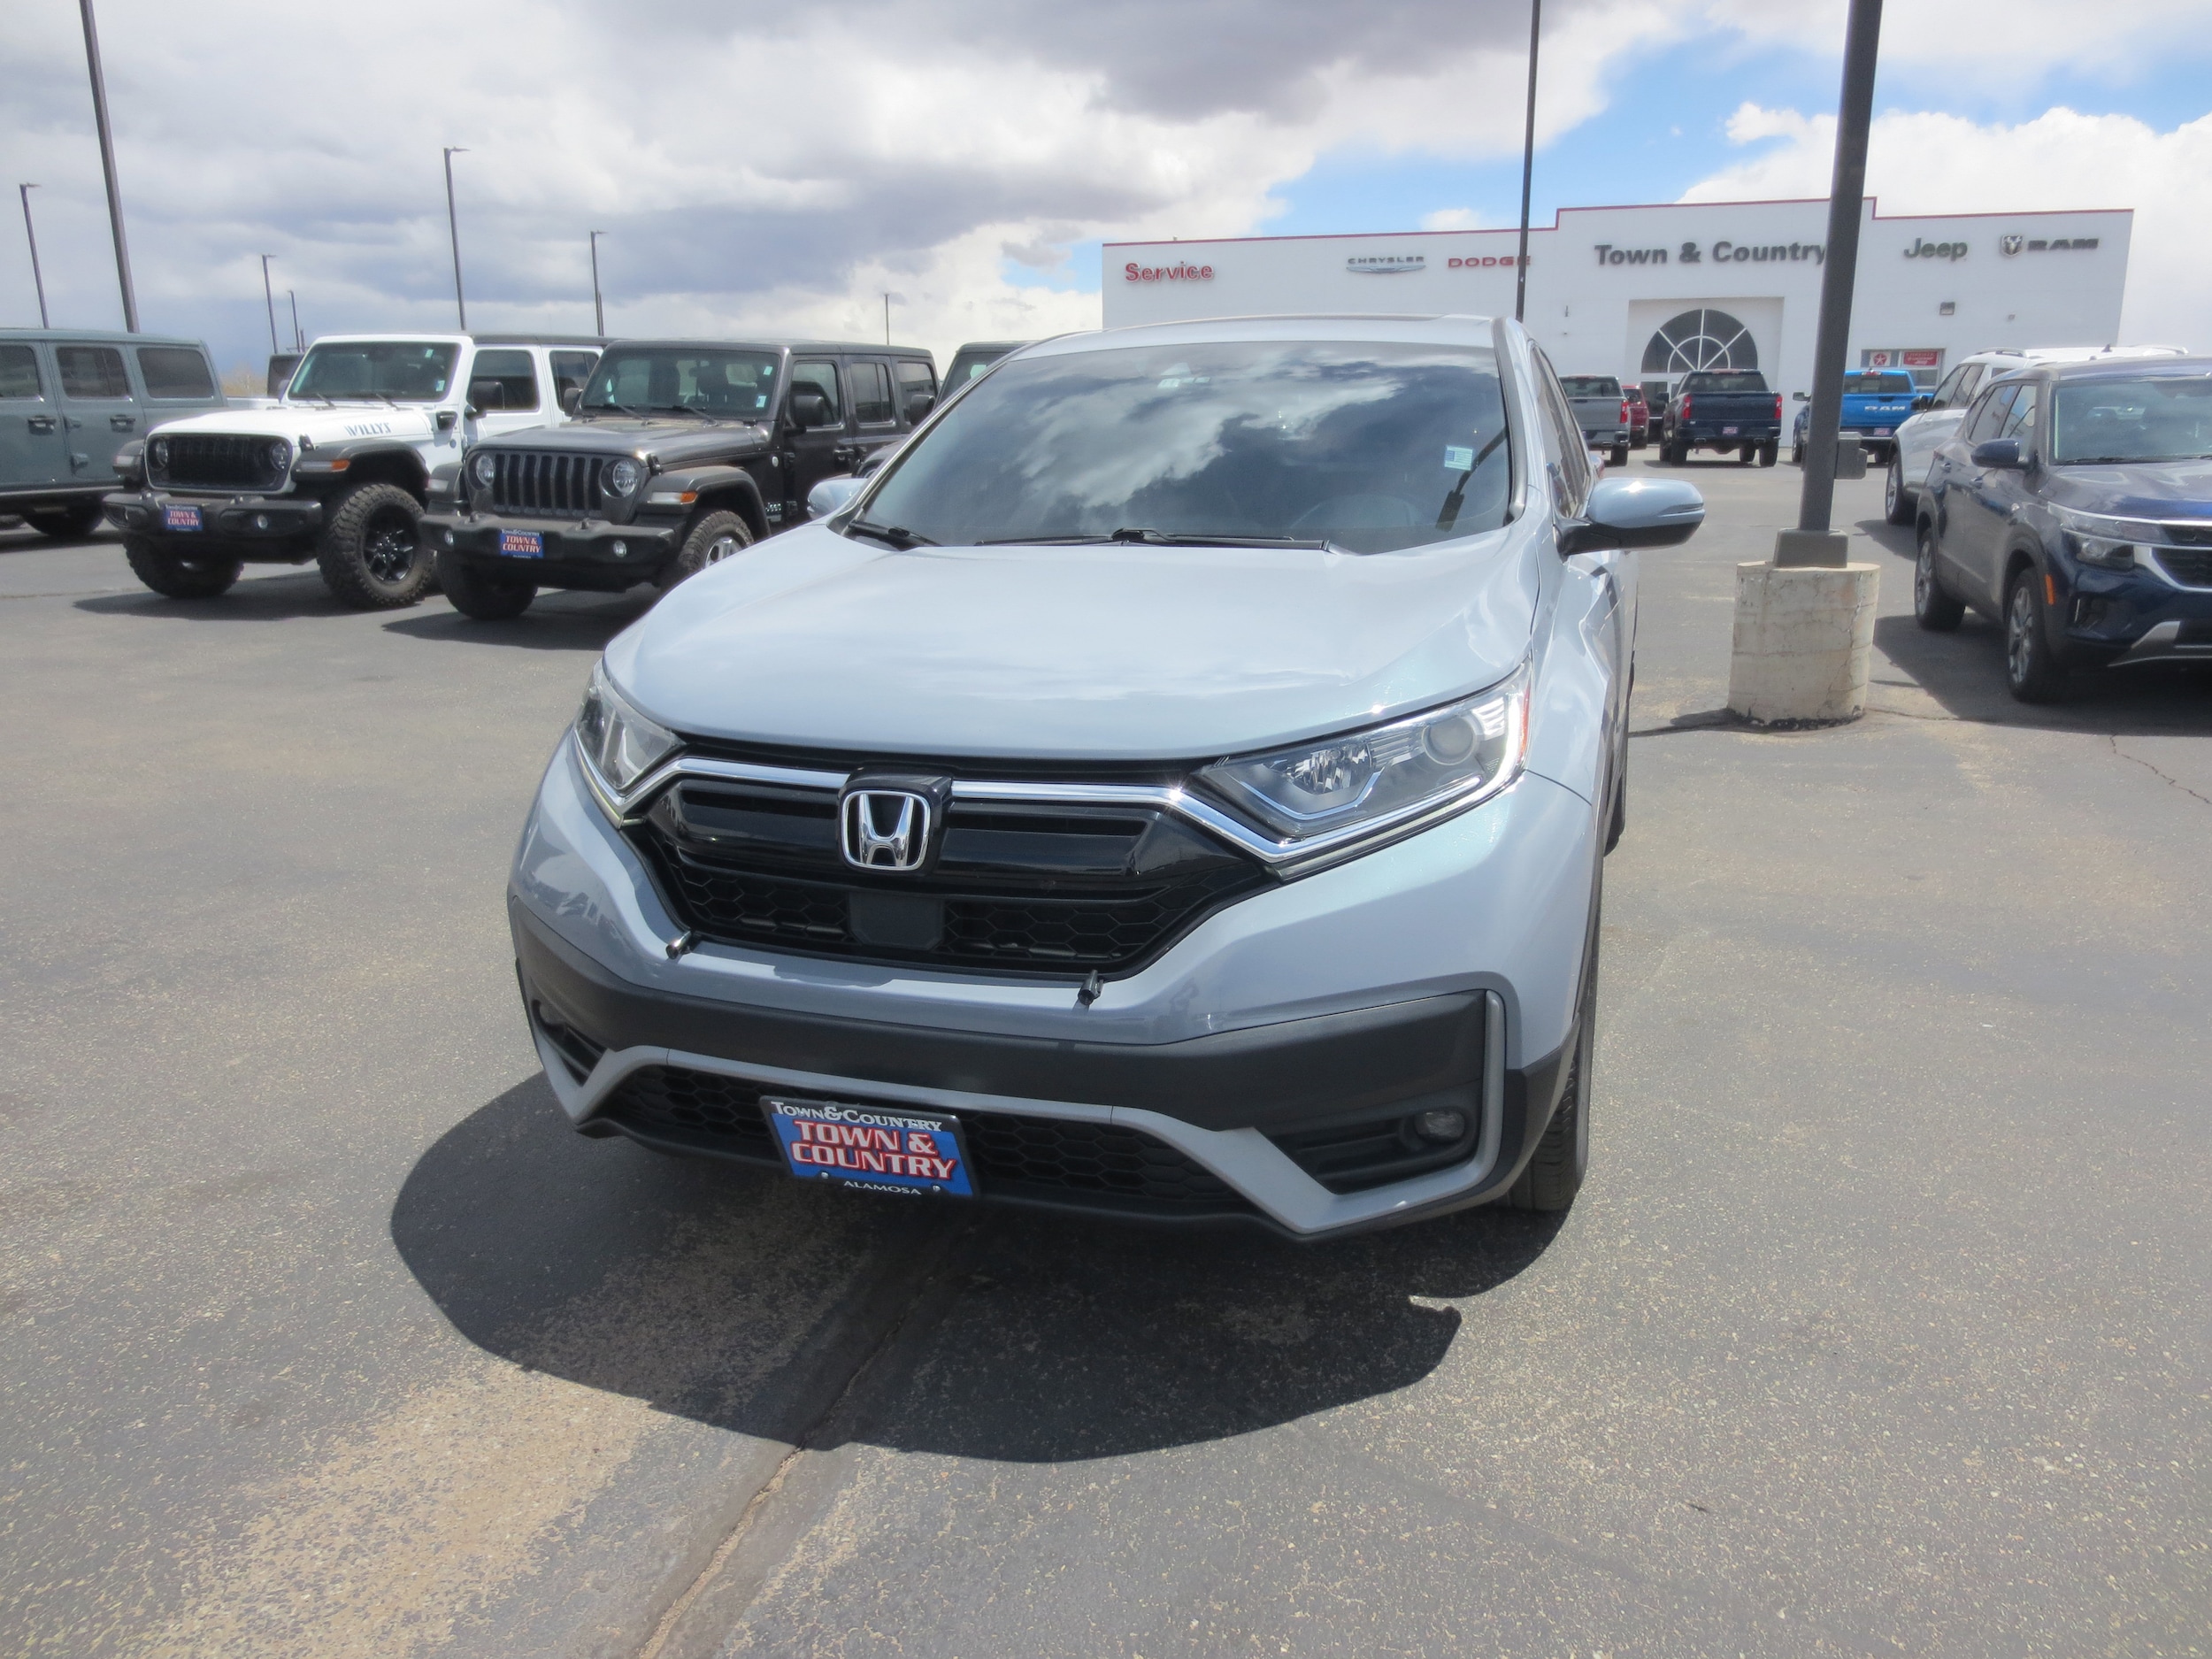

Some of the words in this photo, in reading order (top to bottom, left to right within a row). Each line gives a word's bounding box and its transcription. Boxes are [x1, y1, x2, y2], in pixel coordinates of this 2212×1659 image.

[1903, 237, 1969, 262] Jeep
[2027, 238, 2100, 250] RAM
[1348, 256, 1425, 265] CHRYSLER
[1594, 244, 1668, 265] Town
[1679, 242, 1701, 264] &
[1712, 241, 1826, 265] Country
[1125, 260, 1214, 282] Service
[343, 422, 392, 437] WILLYS
[506, 534, 530, 544] TOWN
[502, 542, 541, 553] COUNTRY
[793, 1120, 901, 1152] TOWN
[908, 1131, 939, 1156] &
[790, 1141, 958, 1180] COUNTRY
[843, 1180, 922, 1195] ALAMOSA
